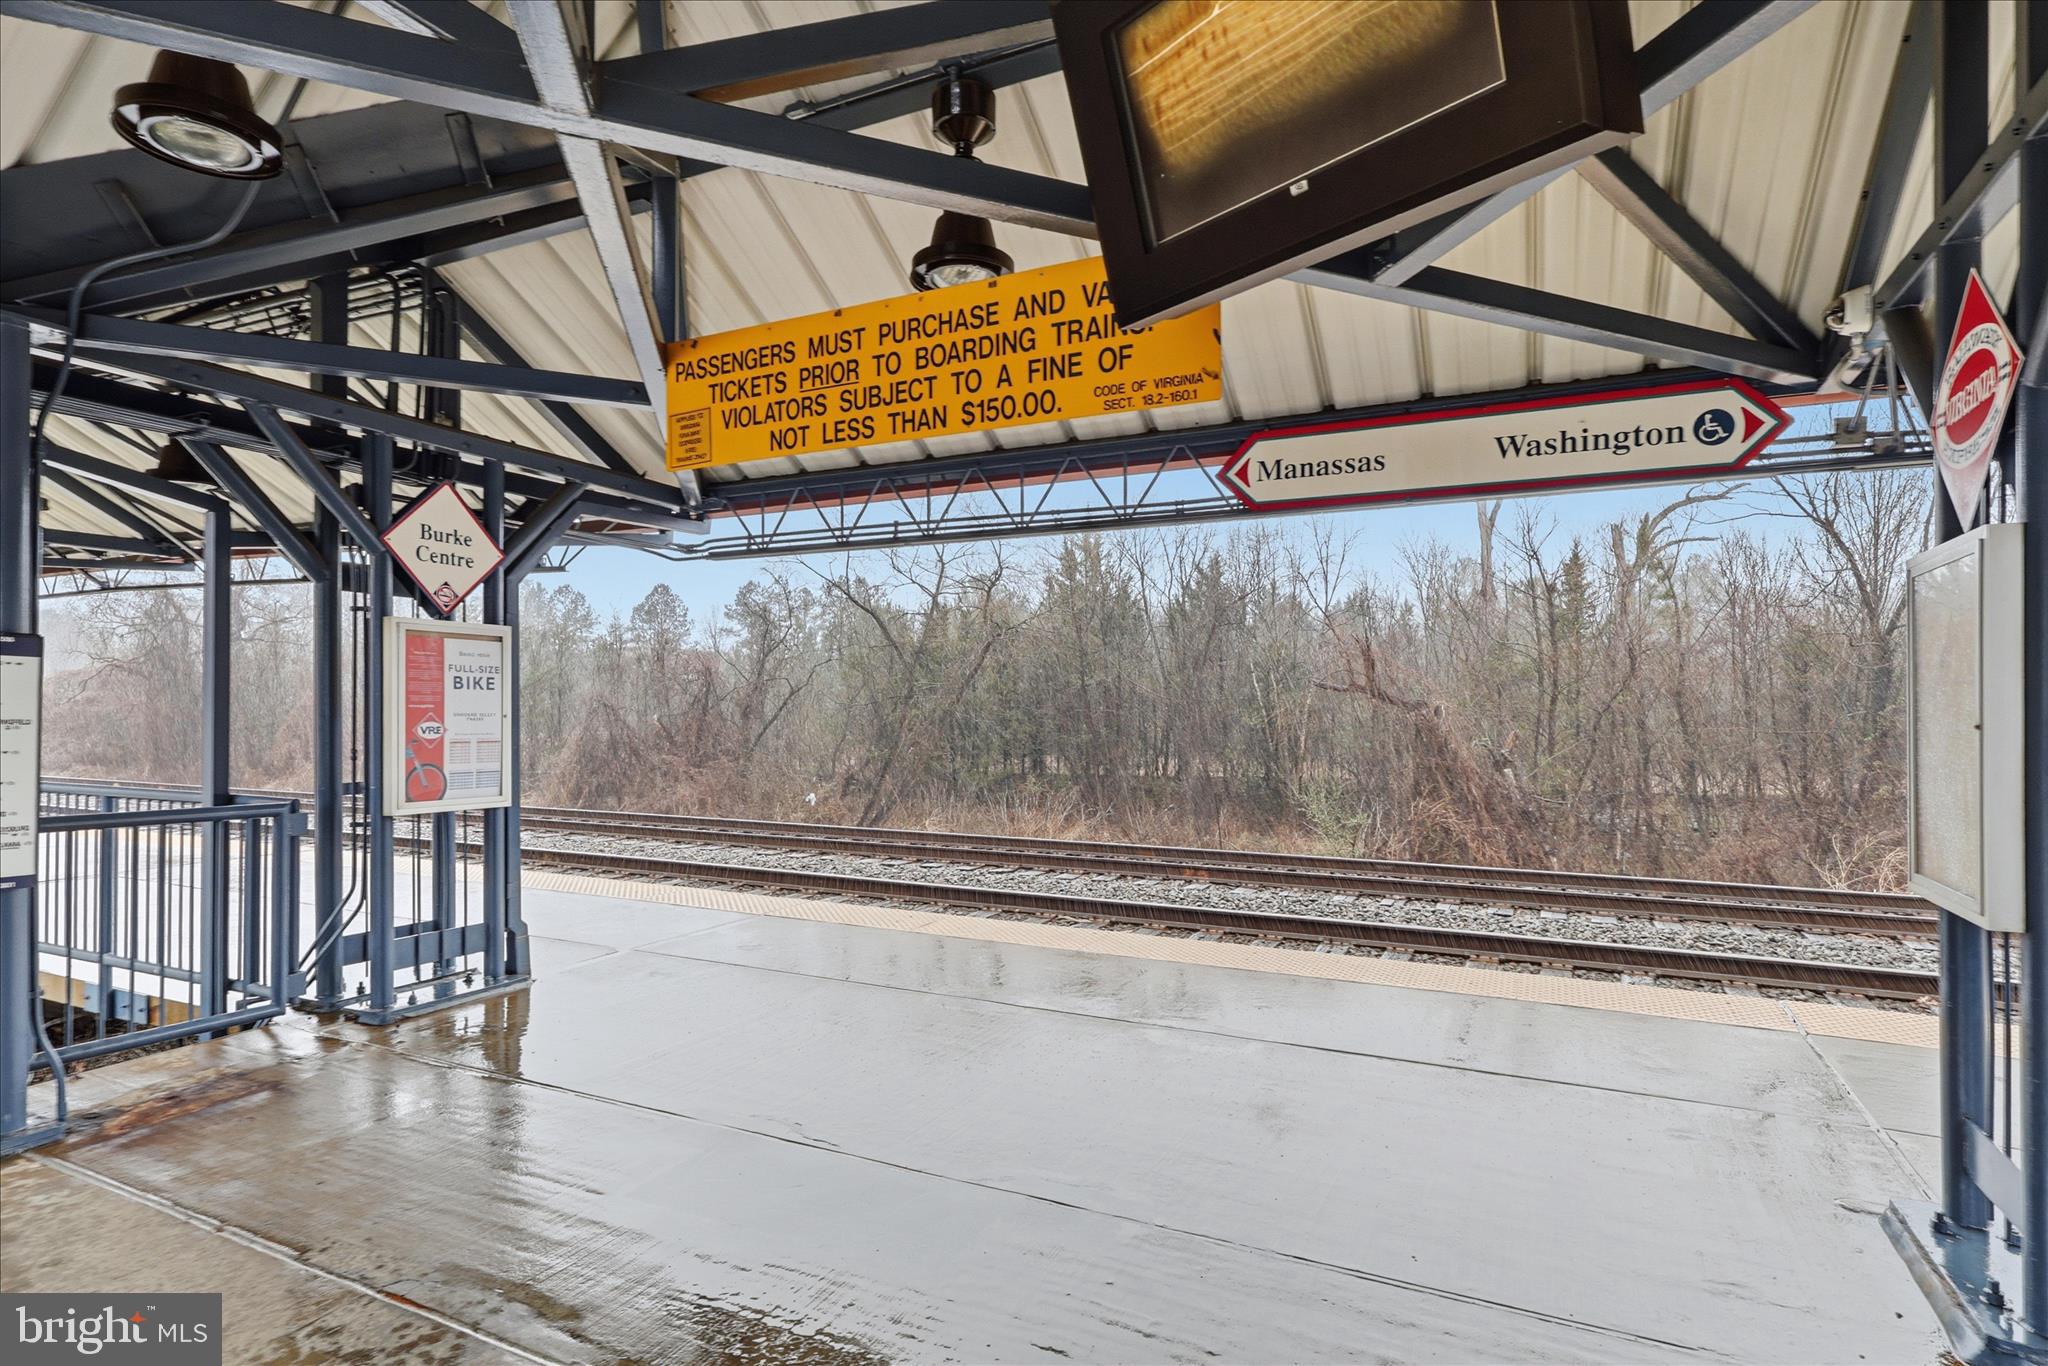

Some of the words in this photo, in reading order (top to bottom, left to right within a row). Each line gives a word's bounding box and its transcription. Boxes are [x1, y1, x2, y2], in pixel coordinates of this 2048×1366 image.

[676, 340, 796, 382] PASSENGERS
[808, 327, 866, 359] MUST
[879, 301, 999, 346] PURCHASE
[1014, 289, 1065, 321] AND
[709, 371, 787, 404] TICKETS
[799, 359, 860, 390] PRIOR
[872, 351, 901, 376] TO
[915, 327, 1036, 370] BOARDING
[1051, 313, 1153, 347] TRAIN.
[721, 393, 828, 429] VIOLATORS
[839, 375, 938, 413] SUBJECT
[950, 368, 982, 395] TO
[996, 364, 1013, 389] A
[1027, 352, 1083, 384] FINE
[1098, 344, 1134, 373] OF
[1093, 383, 1126, 398] CODE
[1131, 379, 1148, 393] OF
[1153, 372, 1204, 390] VIRGINIA
[1103, 397, 1135, 411] SECT.
[770, 425, 811, 452] NOT
[822, 416, 875, 444] LESS
[887, 405, 947, 435] THAN
[961, 389, 1062, 427] $150.00.
[1493, 425, 1687, 459] Washington
[1256, 455, 1385, 482] Manassas
[420, 523, 473, 547] Burke
[416, 545, 474, 569] Centre
[448, 664, 500, 675] FULL-SIZE
[453, 676, 496, 690] BIKE
[420, 726, 442, 735] VRE
